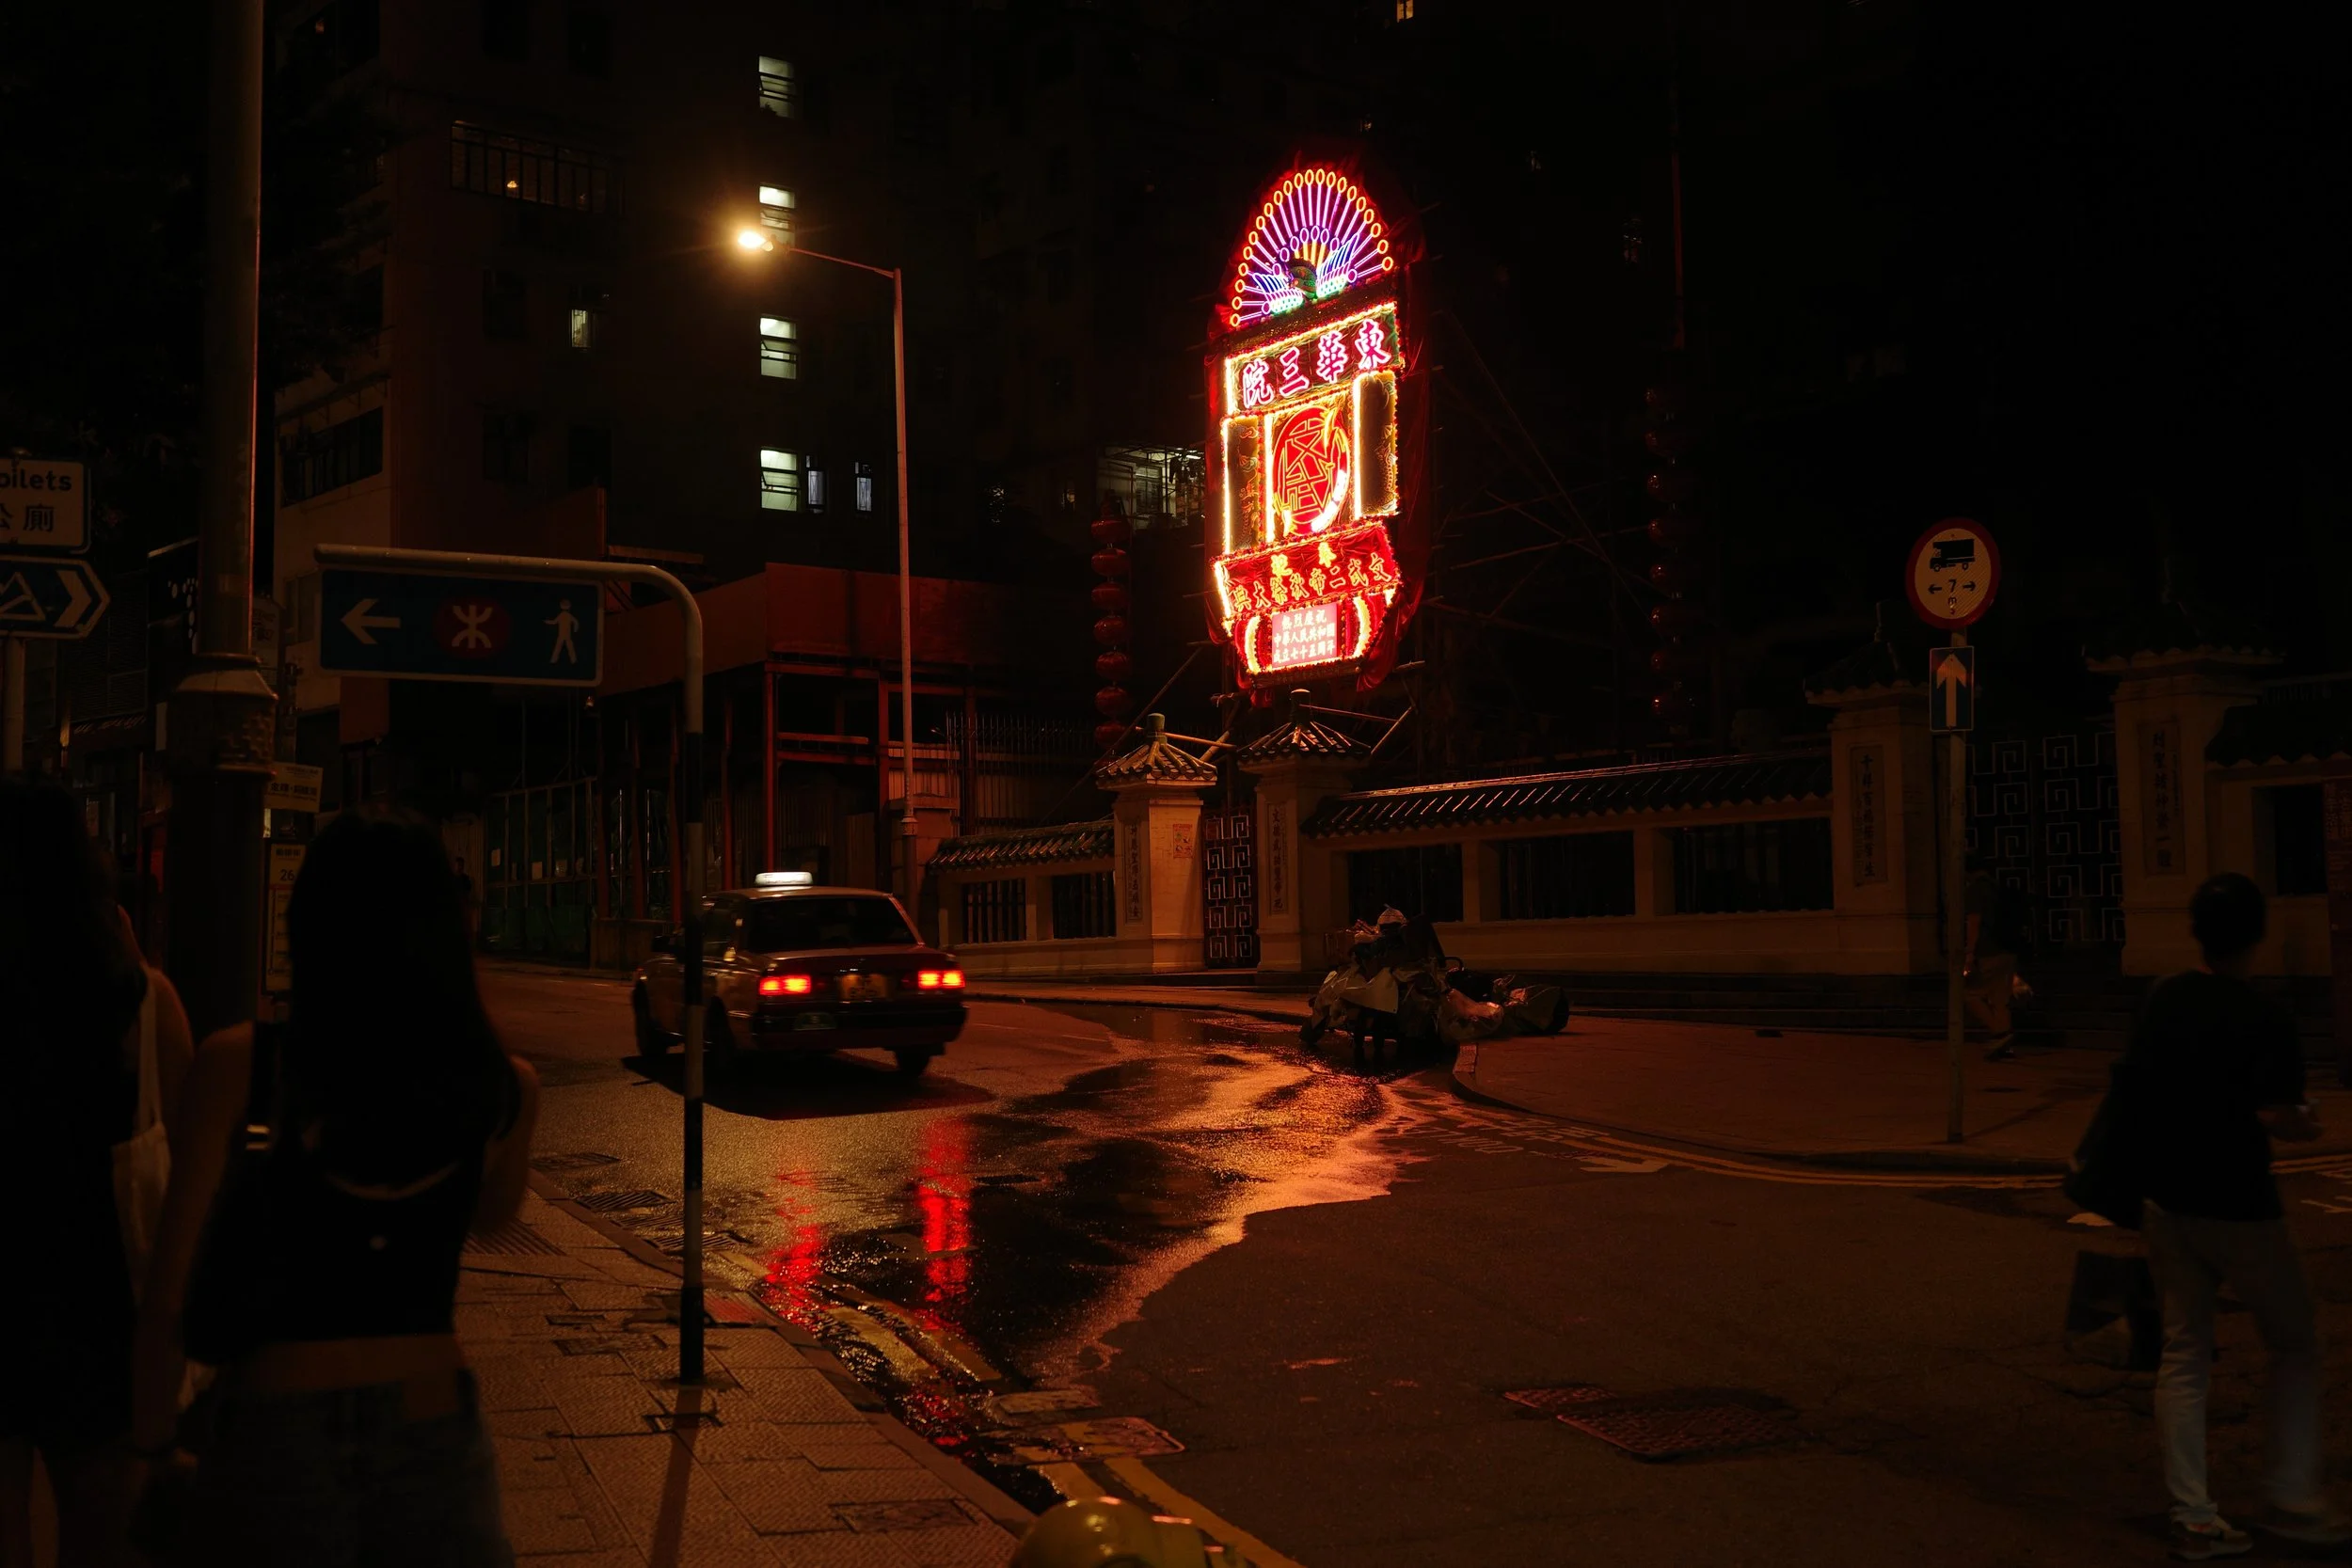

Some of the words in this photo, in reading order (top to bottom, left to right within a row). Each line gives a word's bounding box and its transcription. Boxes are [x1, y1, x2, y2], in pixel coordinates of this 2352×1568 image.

[1242, 319, 1391, 408] 東華三院
[1233, 552, 1391, 612] 文武二帝秋祭大典
[1948, 578, 1957, 593] 7
[1274, 623, 1335, 647] 中華人民共和國
[279, 869, 295, 881] 26
